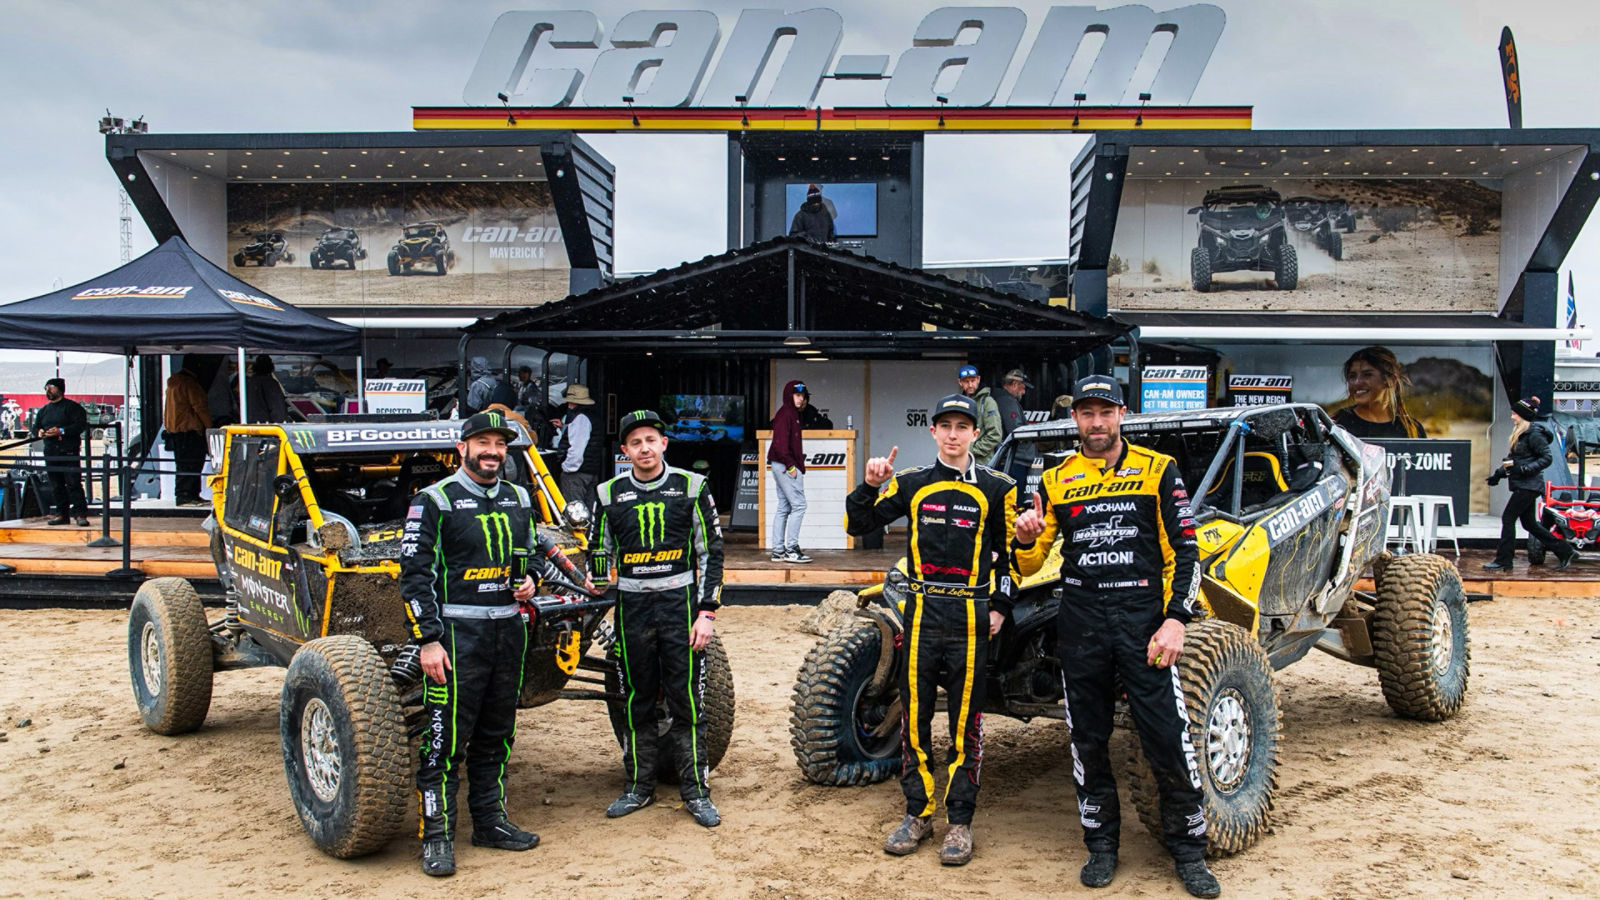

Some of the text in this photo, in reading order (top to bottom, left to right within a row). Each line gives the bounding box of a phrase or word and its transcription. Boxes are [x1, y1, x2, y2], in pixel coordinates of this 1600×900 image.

[463, 4, 1227, 108] can-am
[490, 247, 537, 259] MAVERICK
[1144, 368, 1206, 379] can-am
[365, 381, 424, 392] can-am
[1230, 376, 1292, 387] can-am
[1573, 382, 1600, 391] TRUC
[1144, 389, 1204, 399] CAN-AM OWNERS
[1234, 394, 1286, 404] THE NEW REIGN
[1143, 401, 1156, 409] GET
[1157, 401, 1168, 409] THE
[906, 414, 928, 427] SPA
[327, 428, 461, 442] BFGoodrich
[1415, 453, 1452, 470] ZONE
[1063, 480, 1144, 501] can-am
[1084, 502, 1137, 514] YOKOHAMA
[1268, 490, 1326, 541] can-am
[1075, 527, 1137, 541] MOMENTUM
[234, 546, 282, 581] can-am
[623, 549, 683, 564] can-am
[463, 566, 511, 580] can-a
[241, 574, 291, 614] MONSTER
[250, 600, 284, 623] ENERGY
[428, 708, 444, 768] MONSER
